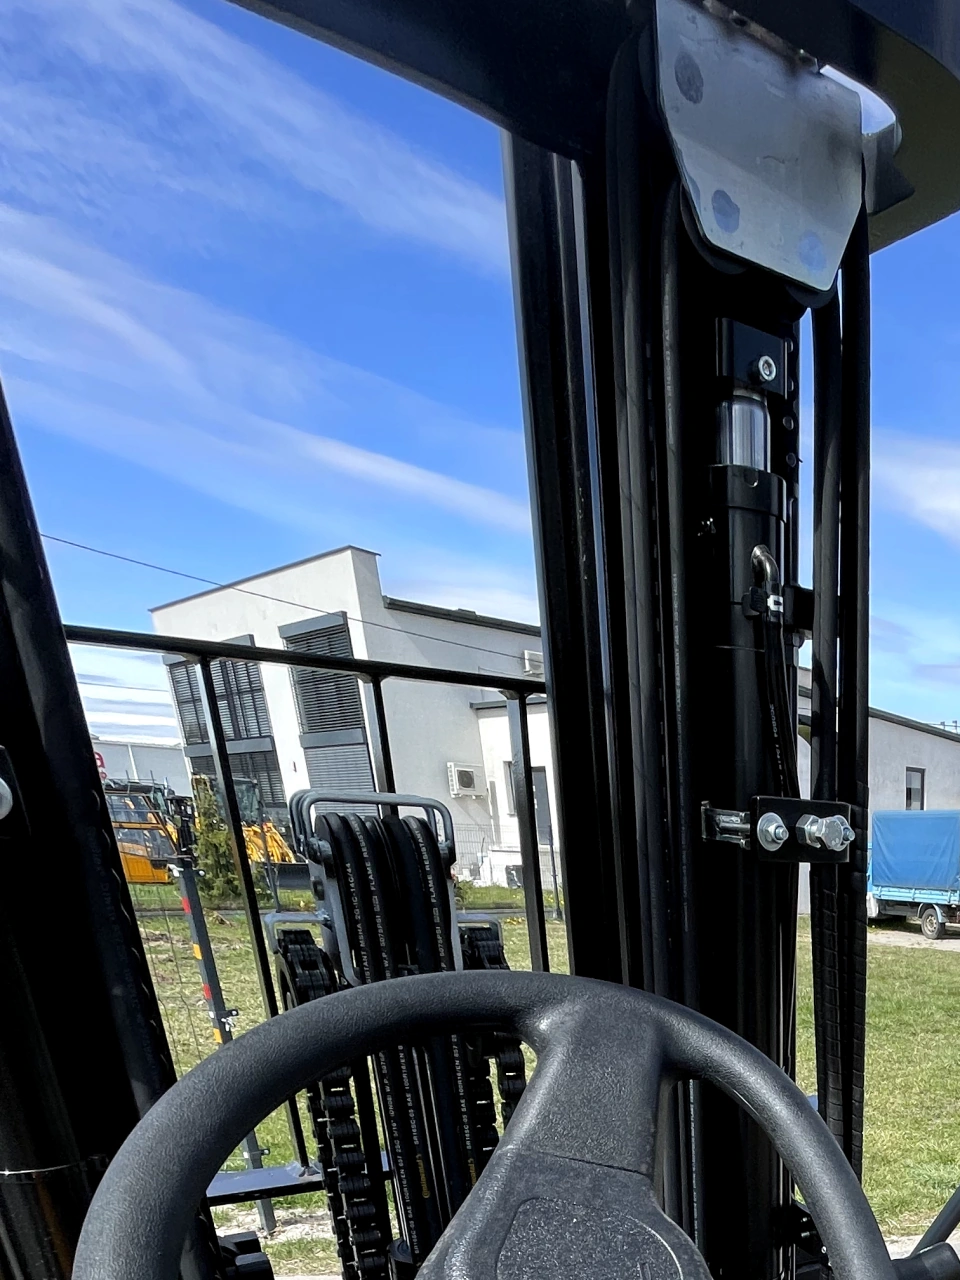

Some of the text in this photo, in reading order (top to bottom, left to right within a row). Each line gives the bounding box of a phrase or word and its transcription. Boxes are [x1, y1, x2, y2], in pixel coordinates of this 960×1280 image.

[416, 830, 430, 870] RESISTANT
[365, 861, 376, 890] FLAME
[427, 874, 437, 902] FLAME
[356, 923, 366, 947] MSHA
[361, 951, 372, 983] SISTANT
[416, 1160, 431, 1198] Continental
